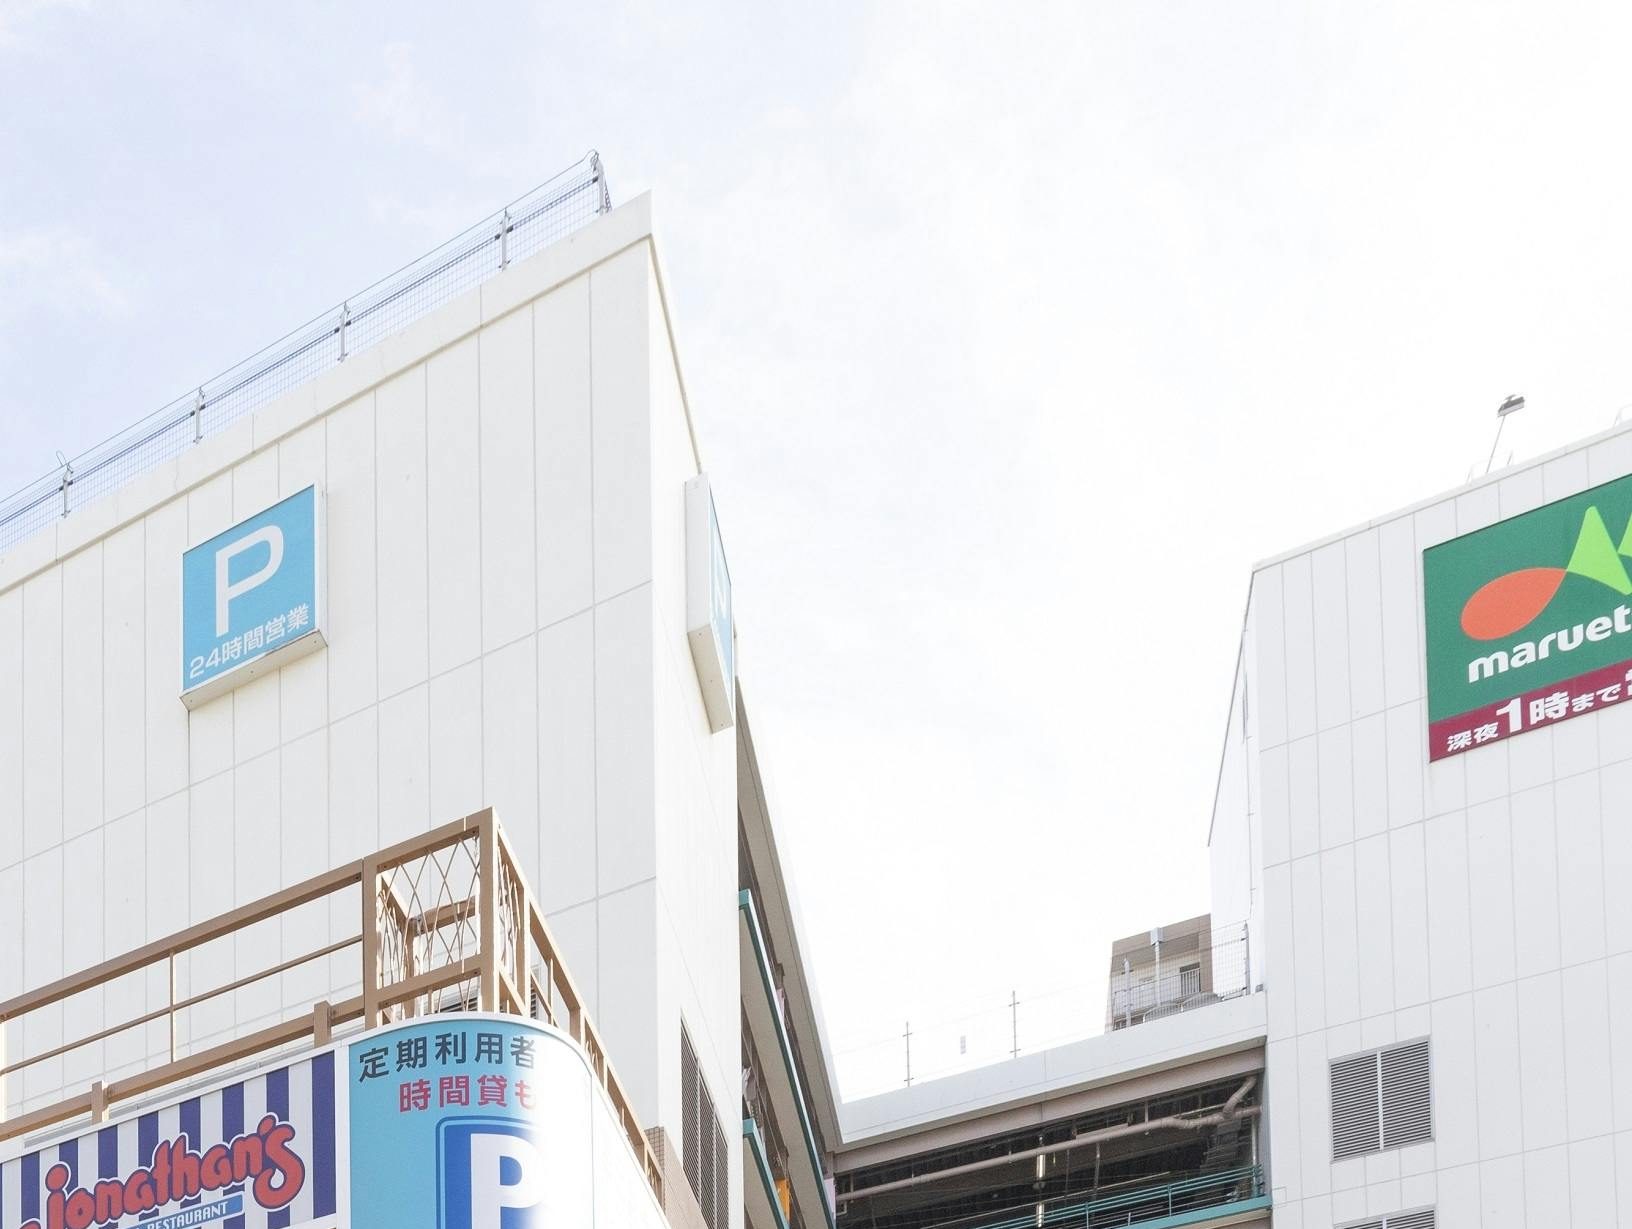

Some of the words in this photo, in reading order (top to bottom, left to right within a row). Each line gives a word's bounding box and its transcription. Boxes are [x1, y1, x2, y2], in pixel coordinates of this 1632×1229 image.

[216, 524, 283, 637] P
[189, 603, 309, 679] 24時間営業
[1468, 604, 1632, 683] maruet
